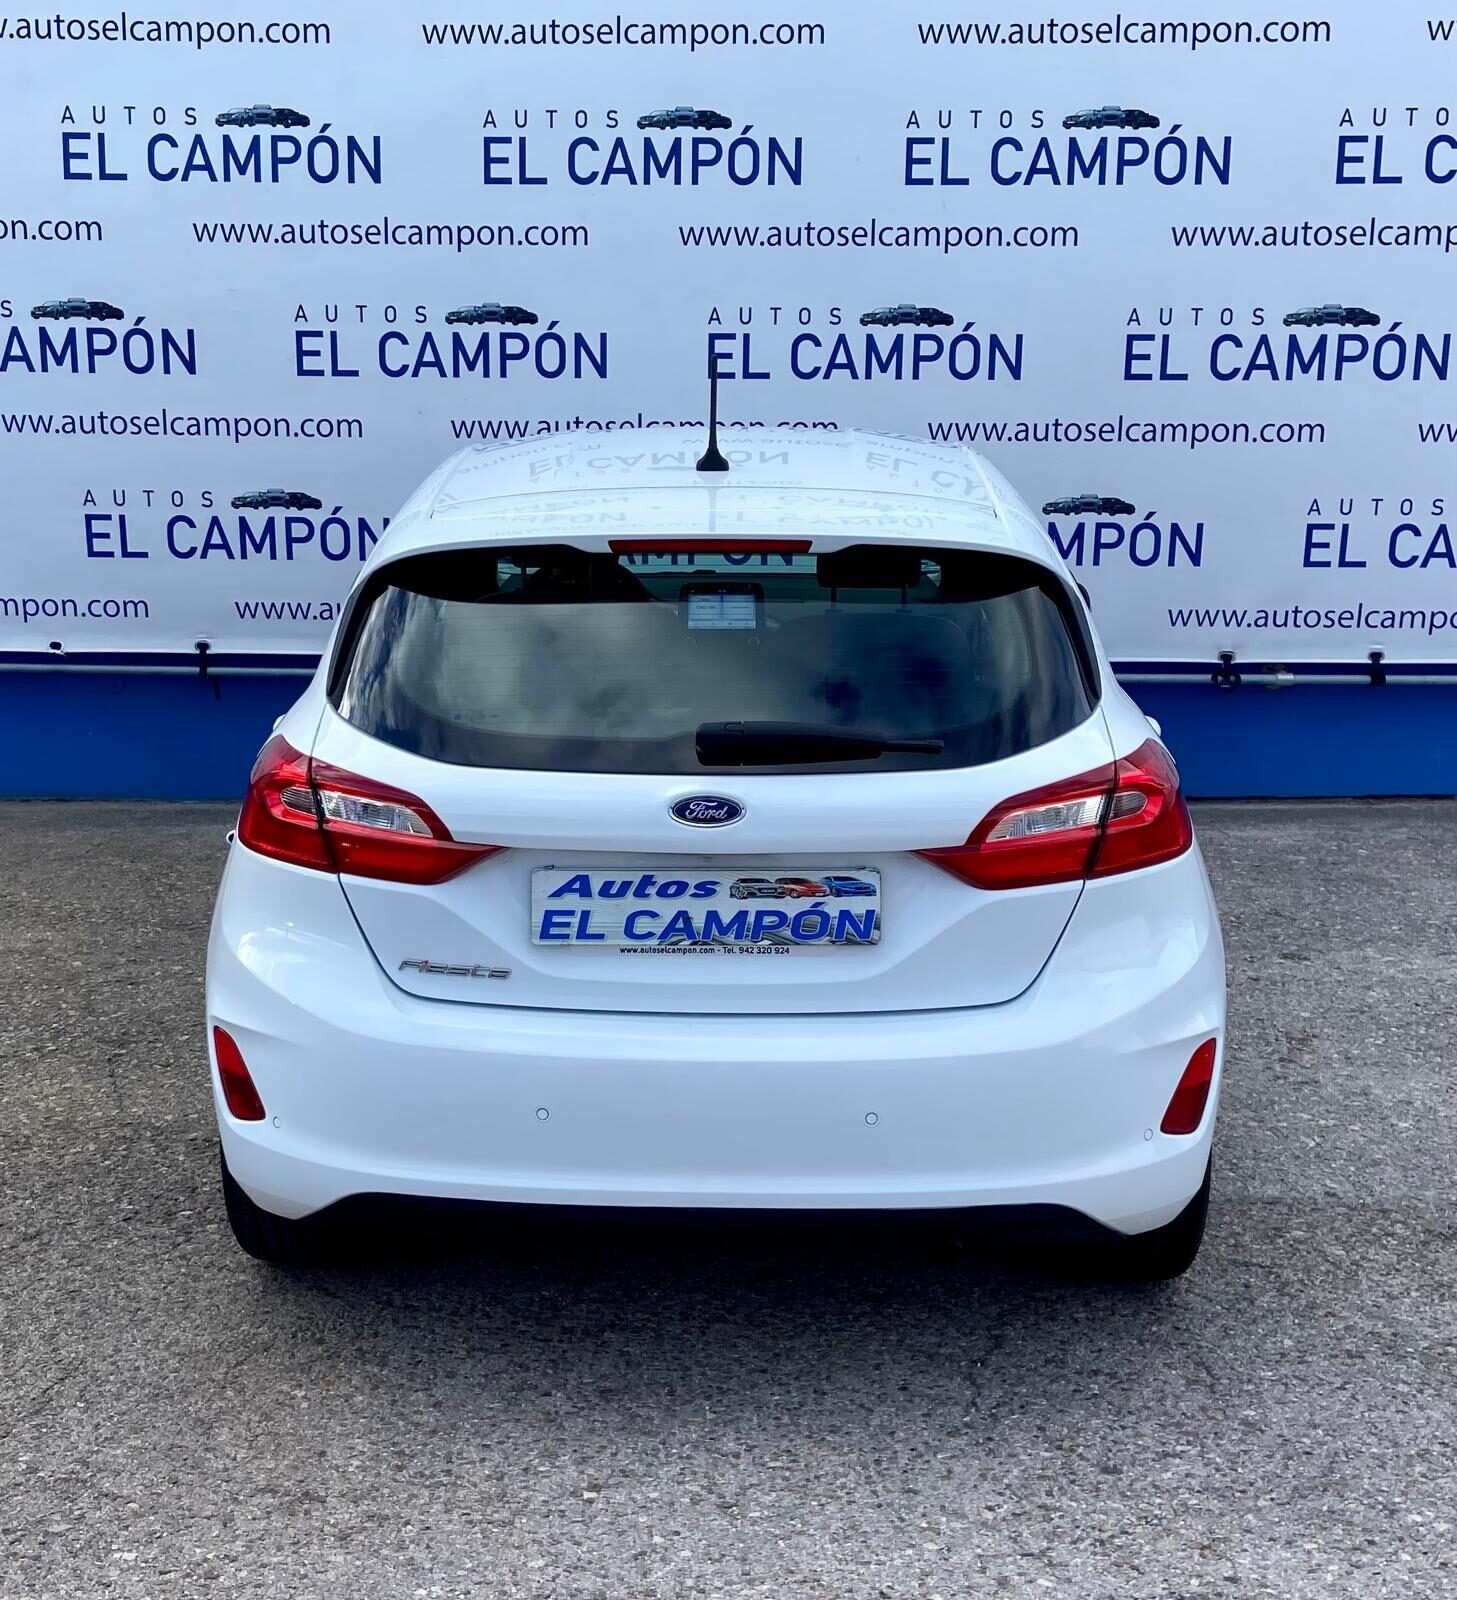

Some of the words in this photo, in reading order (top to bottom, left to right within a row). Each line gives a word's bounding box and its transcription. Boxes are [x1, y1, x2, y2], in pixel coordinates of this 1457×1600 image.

[422, 16, 824, 52] www.autoselcampon.com
[918, 14, 1330, 50] www.autoselcampon.com
[61, 106, 196, 125] AUTOS
[483, 110, 618, 128] AUTOS
[906, 110, 1043, 128] AUTOS
[1339, 108, 1449, 127] AUTO
[62, 132, 127, 180] EL
[148, 124, 381, 184] CAMPÓN
[484, 137, 547, 185] EL
[568, 125, 802, 185] CAMPÓN
[905, 137, 969, 185] EL
[991, 124, 1231, 185] CAMPÓN
[1336, 135, 1402, 184] EL
[193, 217, 587, 252] www.autoselcampon.com
[679, 219, 1078, 254] www.autoselcampon.com
[295, 304, 427, 323] AUTOS
[708, 307, 841, 325] AUTOS
[1127, 308, 1264, 326] AUTOS
[0, 317, 196, 375] AMPÓN
[296, 331, 359, 377] EL
[379, 321, 607, 378] CAMPÓN
[708, 333, 770, 380] EL
[791, 322, 1023, 380] CAMPÓN
[1124, 334, 1188, 380] EL
[1210, 322, 1451, 381] CAMPÓN
[1, 409, 362, 443] ww.autoselcampon.com
[928, 415, 1324, 449] www.autoselcampon.com
[83, 489, 213, 508] AUTOS
[1307, 499, 1443, 515] AUTOS
[85, 514, 148, 558] EL
[167, 506, 390, 561] CAMPÓN
[1303, 523, 1366, 567] EL
[1389, 524, 1457, 568] CA
[685, 801, 729, 820] Ford
[547, 874, 721, 899] Autos
[539, 909, 606, 940] EL
[623, 901, 876, 941] CAMPÓN
[619, 946, 715, 956] www.autoselcampon.com
[723, 946, 737, 955] Tel.
[738, 946, 755, 955] 942
[756, 946, 772, 955] 320
[774, 946, 790, 955] 924
[398, 958, 512, 979] Fiesta
